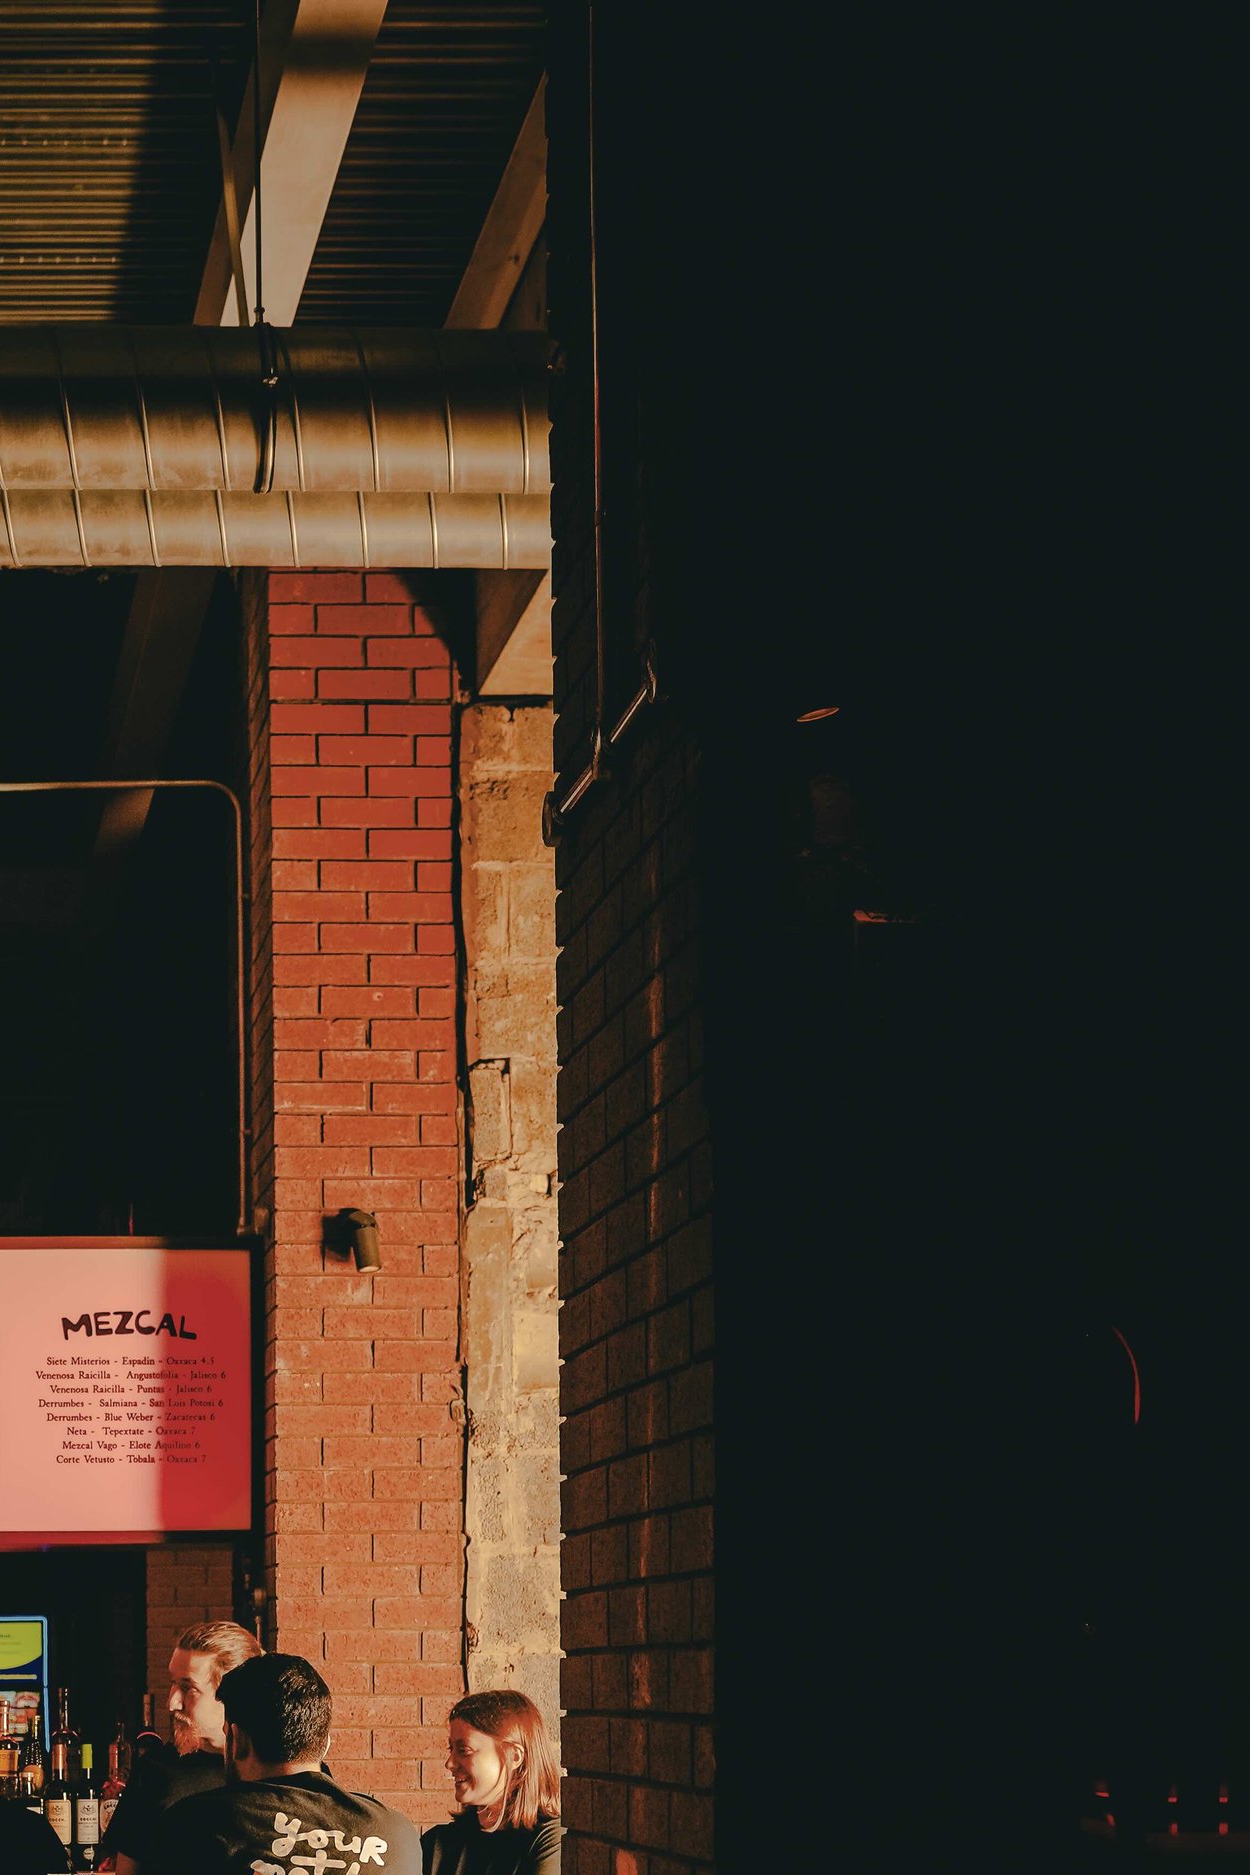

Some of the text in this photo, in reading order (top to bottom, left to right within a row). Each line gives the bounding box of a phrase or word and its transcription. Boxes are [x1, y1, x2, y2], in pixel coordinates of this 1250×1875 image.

[61, 1310, 198, 1341] MEZCAL
[46, 1356, 68, 1366] Siete
[71, 1356, 110, 1366] Misterios
[122, 1356, 155, 1368] Espadin
[166, 1357, 197, 1366] Oaxaca
[35, 1371, 75, 1380] Venenosa
[79, 1371, 111, 1380] Raicilla
[190, 1371, 217, 1381] Jalisco
[220, 1370, 226, 1380] 6
[50, 1385, 89, 1394] Venenosa
[93, 1385, 125, 1394] Raicilla
[137, 1385, 165, 1394] Puntas
[176, 1385, 203, 1395] Jalisco
[206, 1385, 212, 1394] 6
[38, 1399, 85, 1408] Derrumbes
[99, 1399, 138, 1408] Salmiana
[149, 1399, 165, 1408] San
[218, 1399, 224, 1408] 6
[46, 1413, 92, 1422] Derrumbes
[104, 1413, 123, 1422] Blue
[126, 1413, 154, 1422] Weber
[67, 1427, 87, 1436] Neta
[102, 1427, 144, 1438] Tepextate
[62, 1441, 93, 1450] Mezcal
[97, 1441, 118, 1452] Vago
[129, 1441, 152, 1450] Elote
[56, 1455, 80, 1464] Corte
[84, 1455, 115, 1464] Vetusto
[126, 1455, 156, 1464] Tobala
